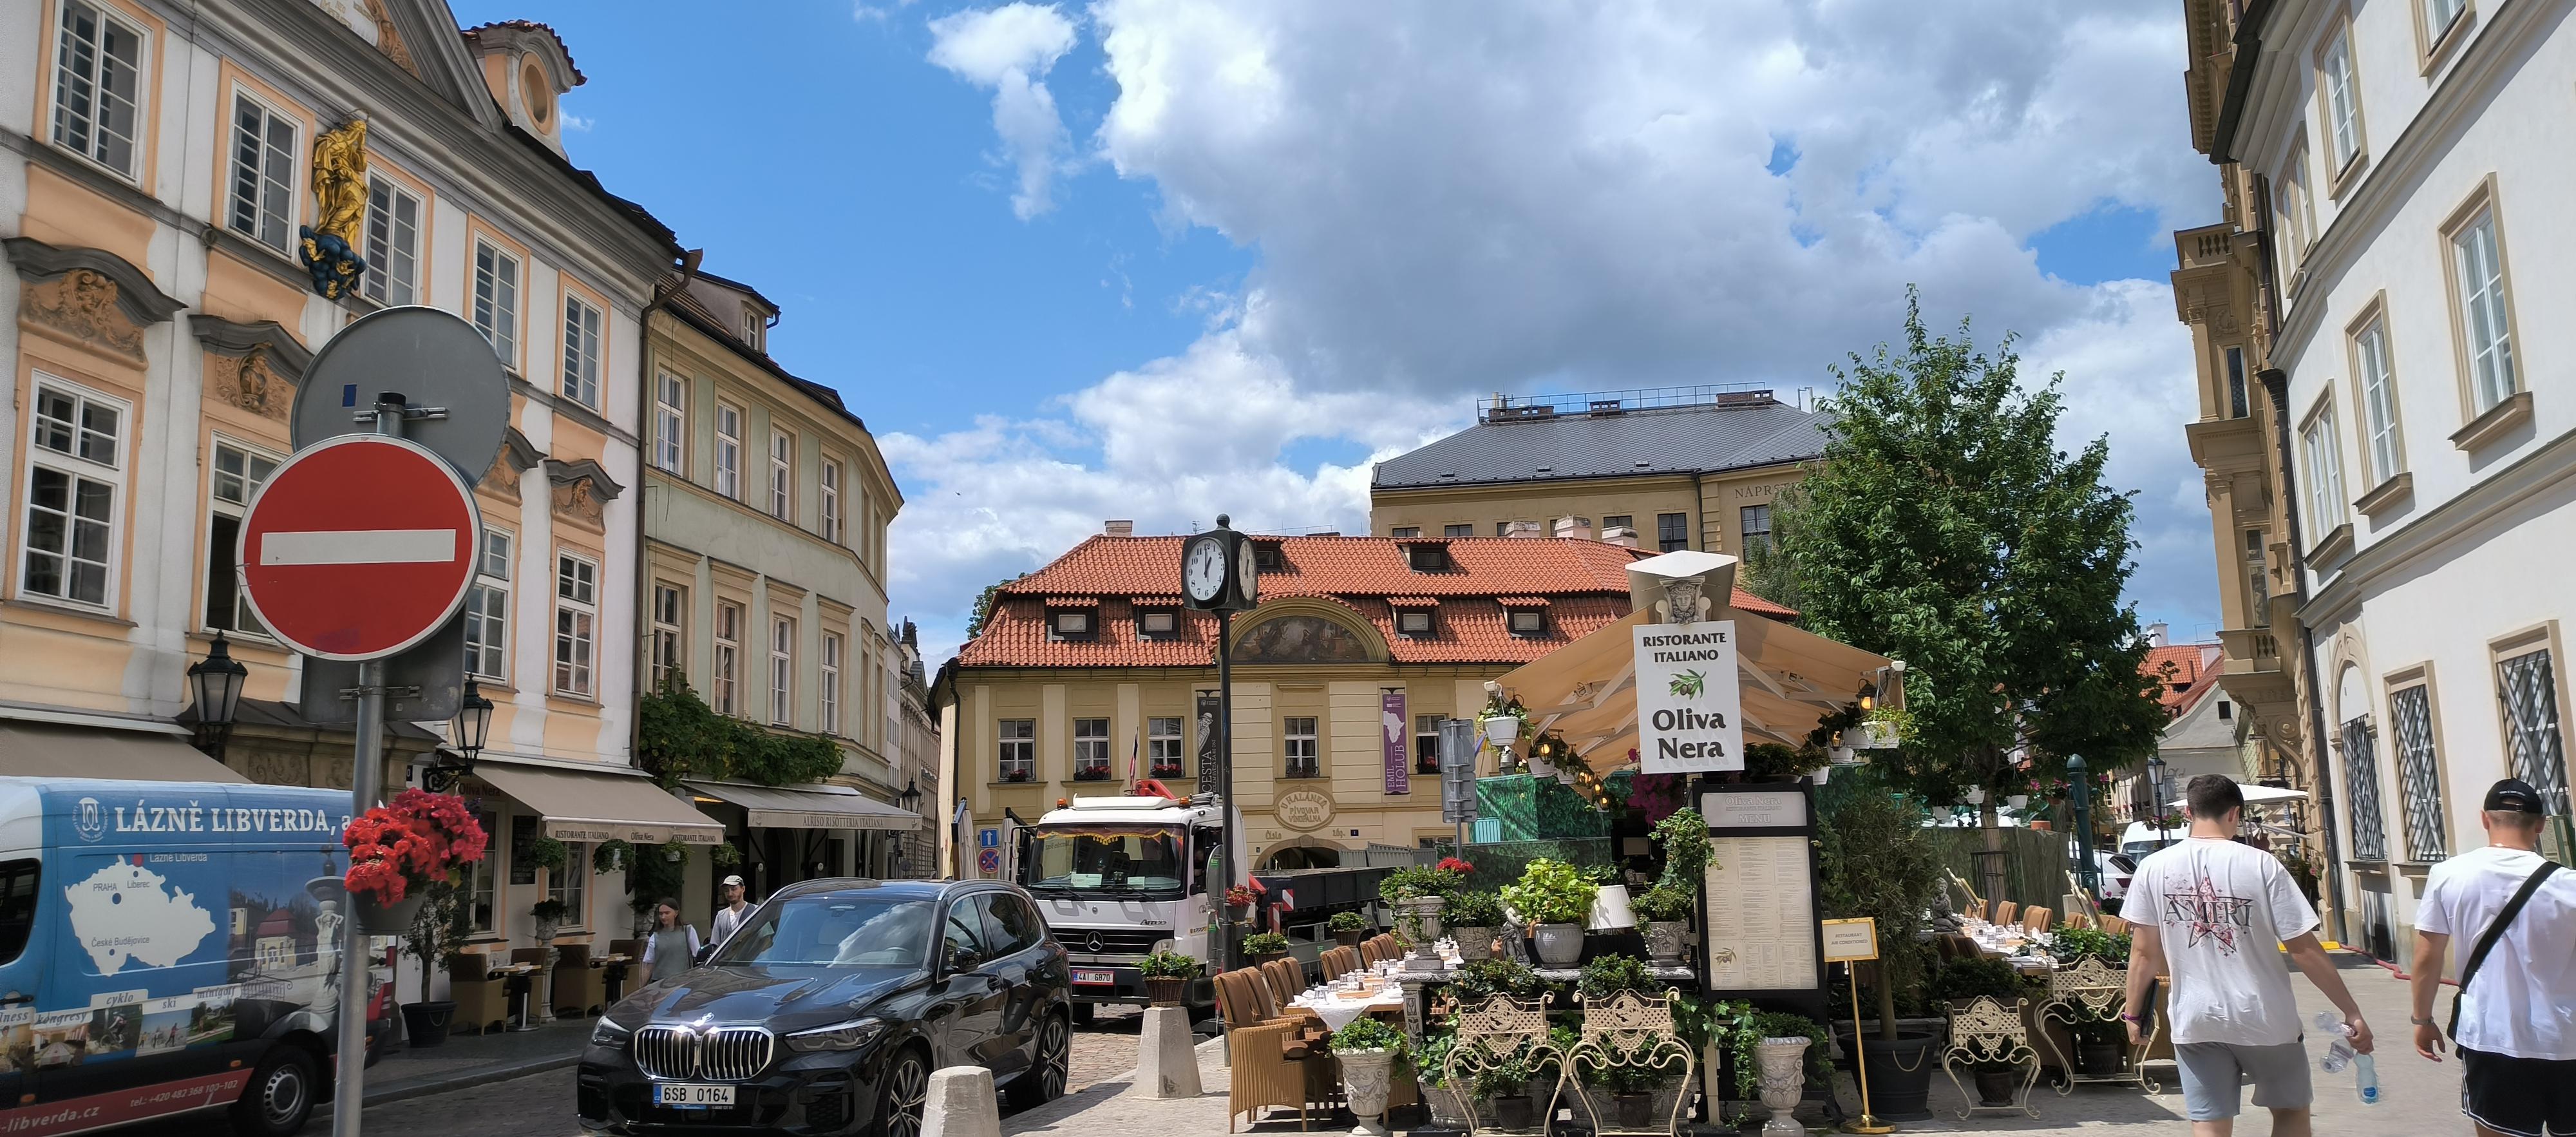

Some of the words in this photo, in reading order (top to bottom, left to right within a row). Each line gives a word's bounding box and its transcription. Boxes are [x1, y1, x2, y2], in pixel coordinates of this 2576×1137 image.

[1213, 544, 1216, 552] 1
[1191, 557, 1198, 565] 10
[1643, 633, 1727, 647] RISTORANTE
[1654, 649, 1719, 663] ITALIANO
[1653, 707, 1727, 731] Oliva
[1657, 737, 1725, 760] Nera
[1202, 750, 1212, 793] CESTA
[1395, 745, 1406, 787] HOLUB
[459, 782, 480, 795] Oliva
[482, 784, 500, 797] Nera
[1725, 795, 1753, 805] Oliva
[1755, 795, 1781, 805] Nera
[114, 799, 204, 832] LÁZNĚ
[211, 808, 336, 836] LIBVERDA,
[826, 816, 858, 828] RISOTTERIA
[860, 817, 884, 828] ITALIANA
[1739, 814, 1771, 823] MENU
[555, 830, 586, 839] RISTORANTE
[587, 831, 609, 839] ITALIANO
[175, 853, 207, 862] Libverda
[93, 883, 117, 892] PRAHA
[2163, 899, 2253, 928] AMIRI
[91, 937, 113, 948] České
[114, 936, 150, 946] Budějovice
[197, 985, 236, 999] minigolf
[106, 993, 134, 1005] cyklo
[162, 998, 177, 1009] ski
[37, 1011, 87, 1025] kongresy
[149, 1092, 170, 1103] +420
[664, 1087, 687, 1102] 6SB
[697, 1088, 728, 1102] 0164
